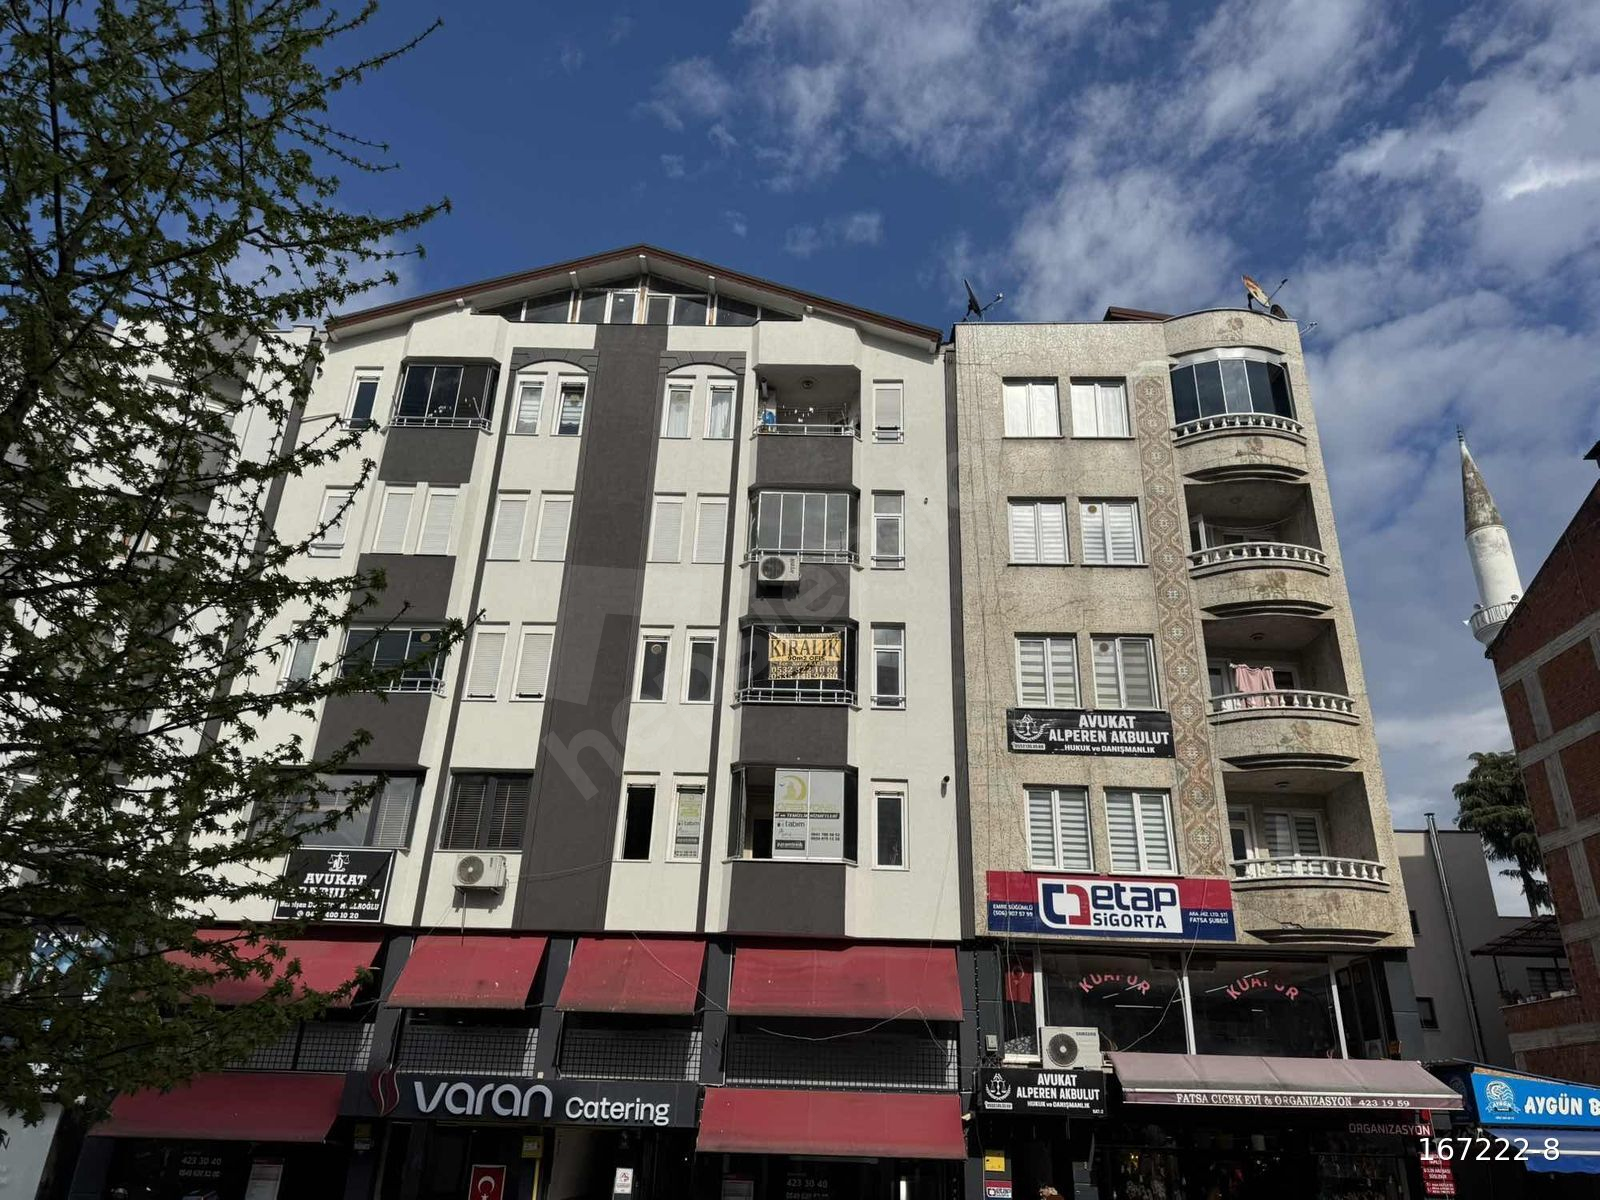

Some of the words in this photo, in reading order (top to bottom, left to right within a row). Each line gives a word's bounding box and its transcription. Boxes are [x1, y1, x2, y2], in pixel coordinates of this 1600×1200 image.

[1079, 714, 1136, 729] AVUKAT
[1049, 729, 1107, 743] ALPEREN
[1111, 730, 1169, 744] AKBULUT
[1064, 744, 1091, 752] HUKUK
[303, 873, 367, 885] AVUKAT
[1091, 883, 1177, 912] etap
[1038, 1073, 1077, 1087] AVUKAT
[1016, 1086, 1057, 1099] ALPEREN
[1059, 1088, 1100, 1100] AKBULUT
[1176, 1093, 1209, 1104] FATSA
[1358, 1099, 1378, 1107] 423
[1397, 1100, 1410, 1108] 59
[413, 1081, 553, 1117] varan
[565, 1096, 670, 1126] Catering
[1524, 1092, 1583, 1115] AYGÜN
